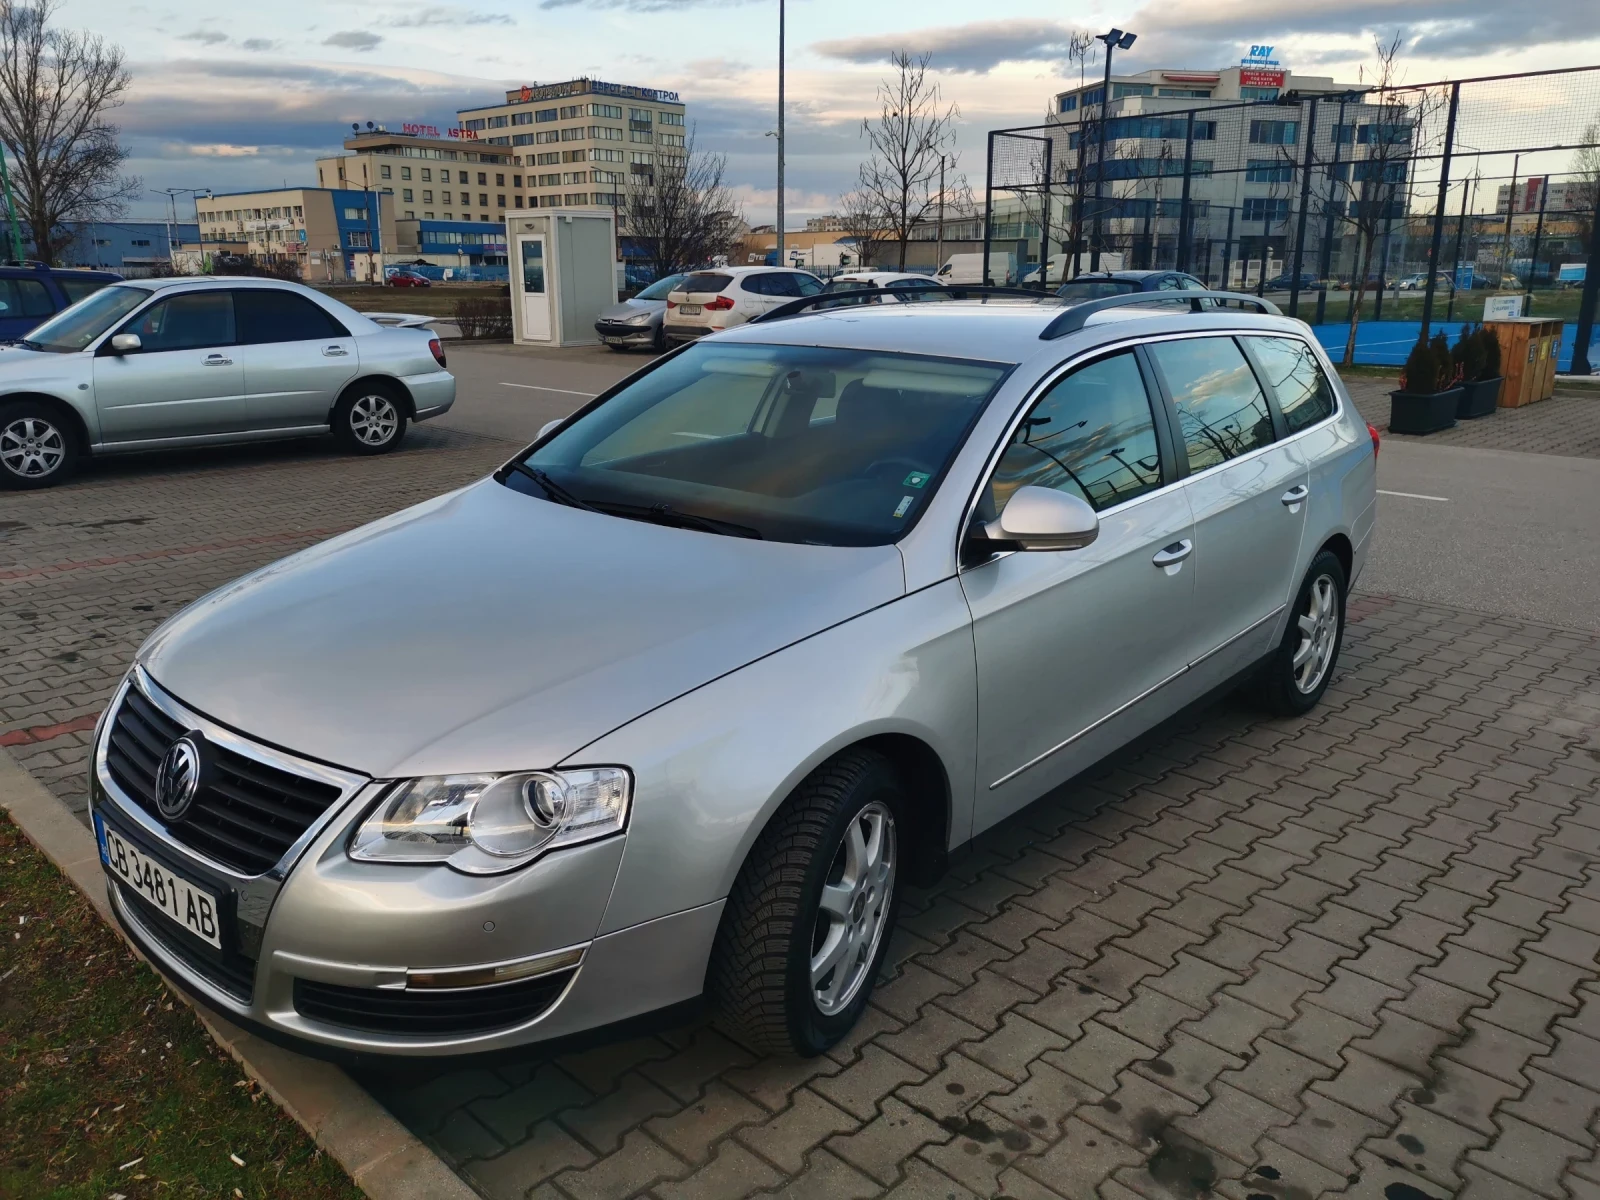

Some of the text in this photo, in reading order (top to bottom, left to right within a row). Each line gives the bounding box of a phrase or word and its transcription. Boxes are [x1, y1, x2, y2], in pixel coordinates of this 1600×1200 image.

[1249, 45, 1274, 57] RAY
[641, 87, 680, 101] КОНТРОЛ
[403, 123, 478, 140] HOTEL ASTRA
[130, 849, 178, 917] 3481
[187, 888, 216, 939] AB
